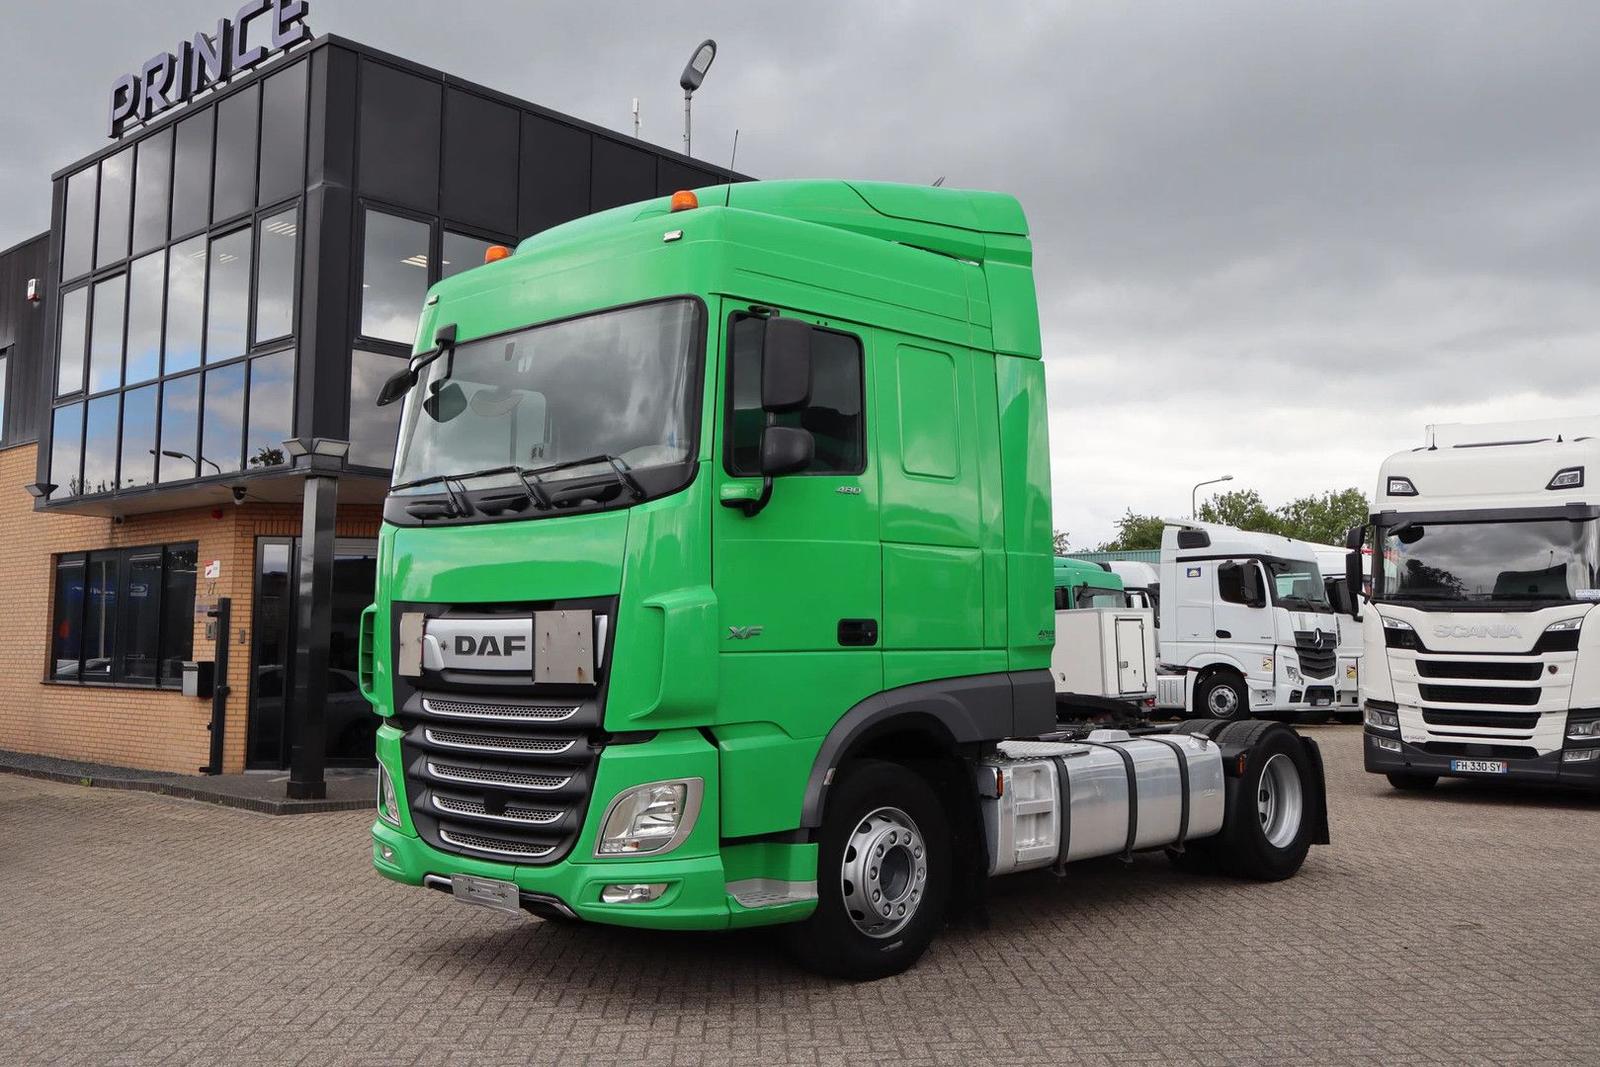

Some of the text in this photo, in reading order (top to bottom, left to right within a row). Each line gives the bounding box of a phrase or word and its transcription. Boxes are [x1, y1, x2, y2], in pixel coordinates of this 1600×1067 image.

[107, 0, 309, 138] PRINCE
[726, 626, 763, 640] XF
[1433, 624, 1522, 639] SCANIA
[454, 635, 526, 657] DAF
